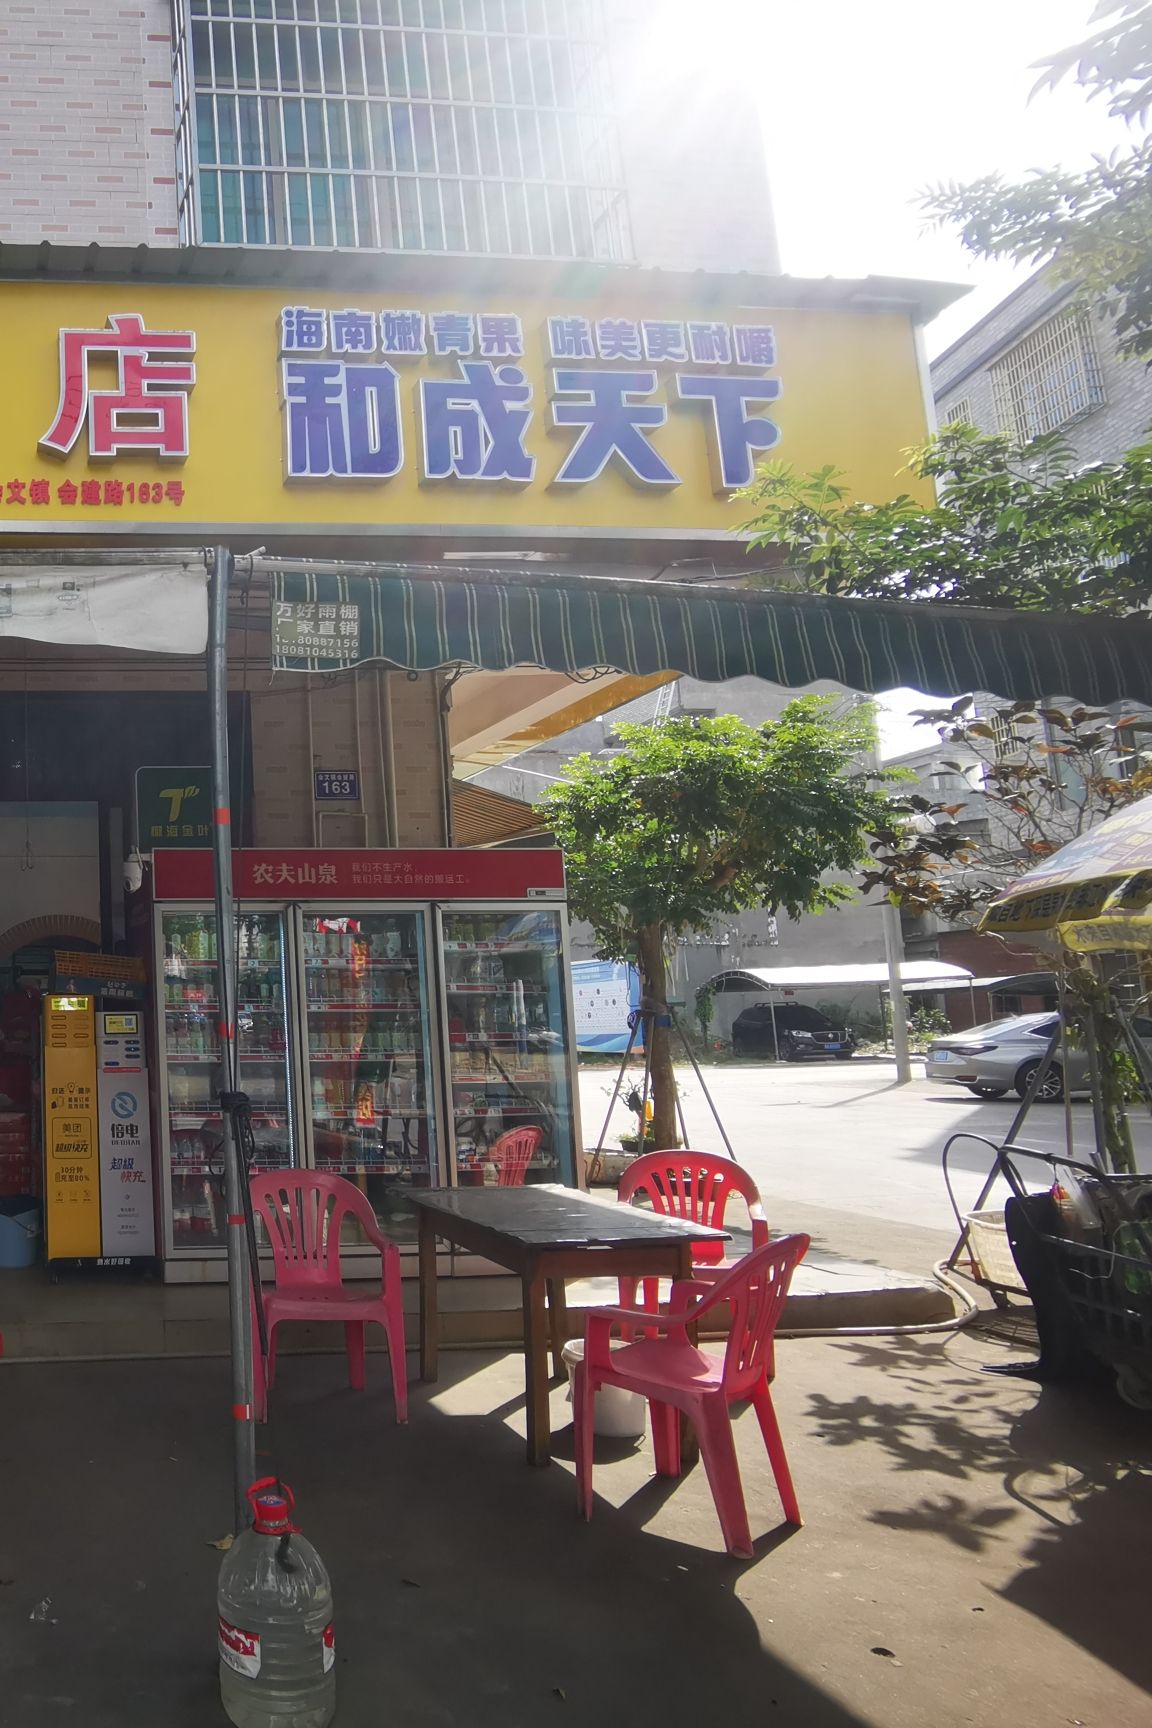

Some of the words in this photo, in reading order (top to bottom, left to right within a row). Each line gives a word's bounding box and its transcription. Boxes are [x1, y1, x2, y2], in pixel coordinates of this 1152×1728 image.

[281, 307, 524, 358] 海南嫩青果
[547, 315, 777, 368] 味美更耐嚼
[281, 358, 782, 487] 和成天下
[275, 602, 359, 619] 万好雨棚
[322, 781, 350, 794] 163
[252, 862, 339, 885] 农夫山泉
